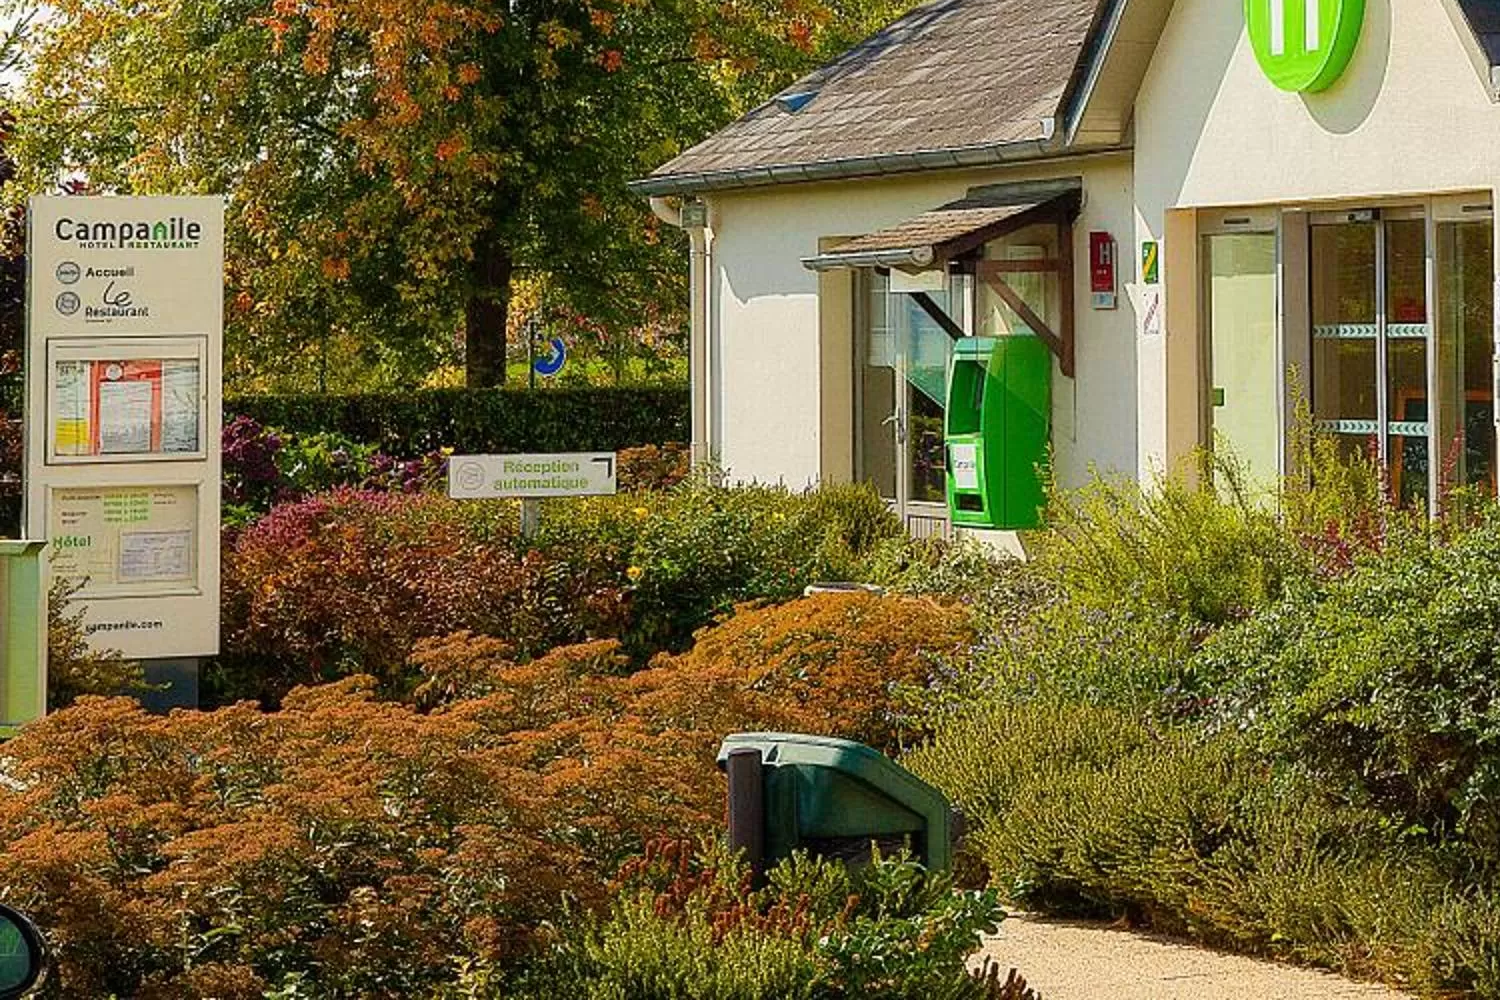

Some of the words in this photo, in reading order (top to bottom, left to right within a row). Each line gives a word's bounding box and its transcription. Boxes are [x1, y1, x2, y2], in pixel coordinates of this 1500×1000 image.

[55, 217, 201, 249] Campanile
[128, 241, 199, 249] RESTAURANT
[85, 267, 135, 277] Accueil
[85, 307, 149, 317] Restaurant
[503, 460, 579, 475] Réception
[493, 477, 588, 491] automatique
[53, 536, 91, 548] Hôtel
